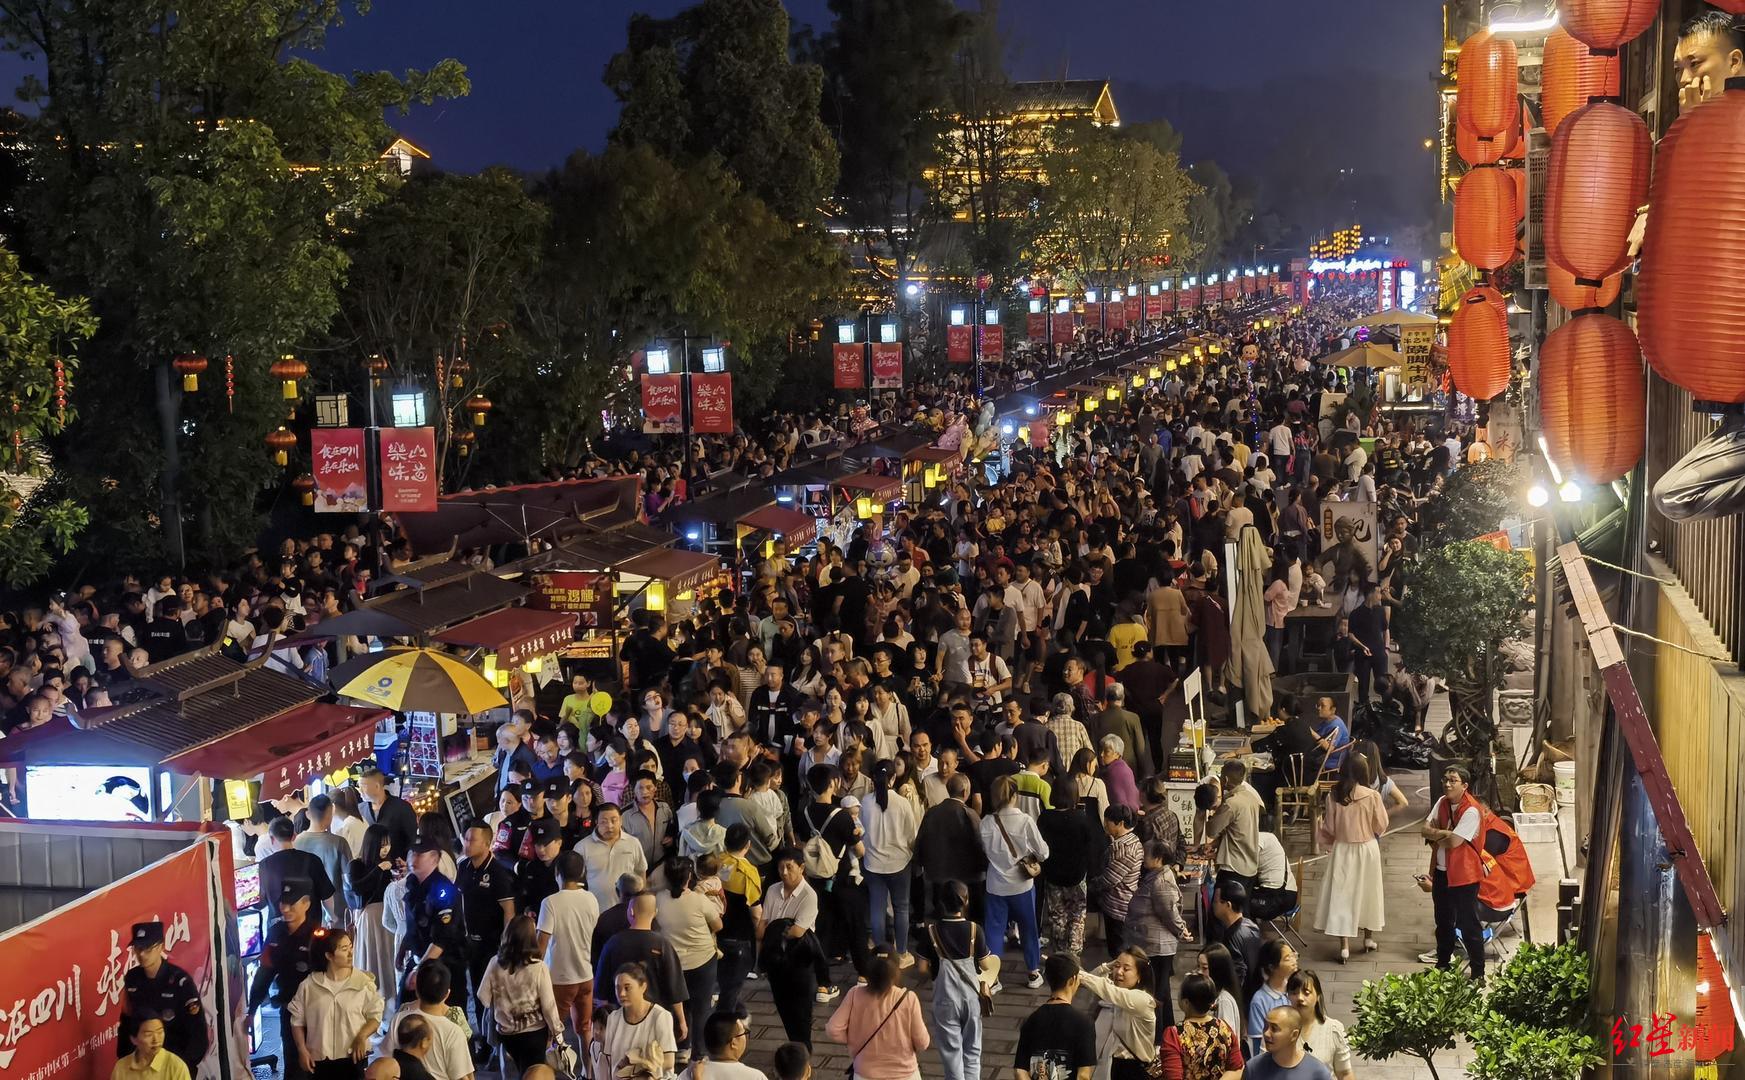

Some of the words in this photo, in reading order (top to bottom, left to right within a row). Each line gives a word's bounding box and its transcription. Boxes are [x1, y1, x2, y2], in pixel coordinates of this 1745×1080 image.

[316, 444, 359, 459] 食在四川
[388, 462, 428, 482] 味道
[0, 964, 82, 1047] 在四川
